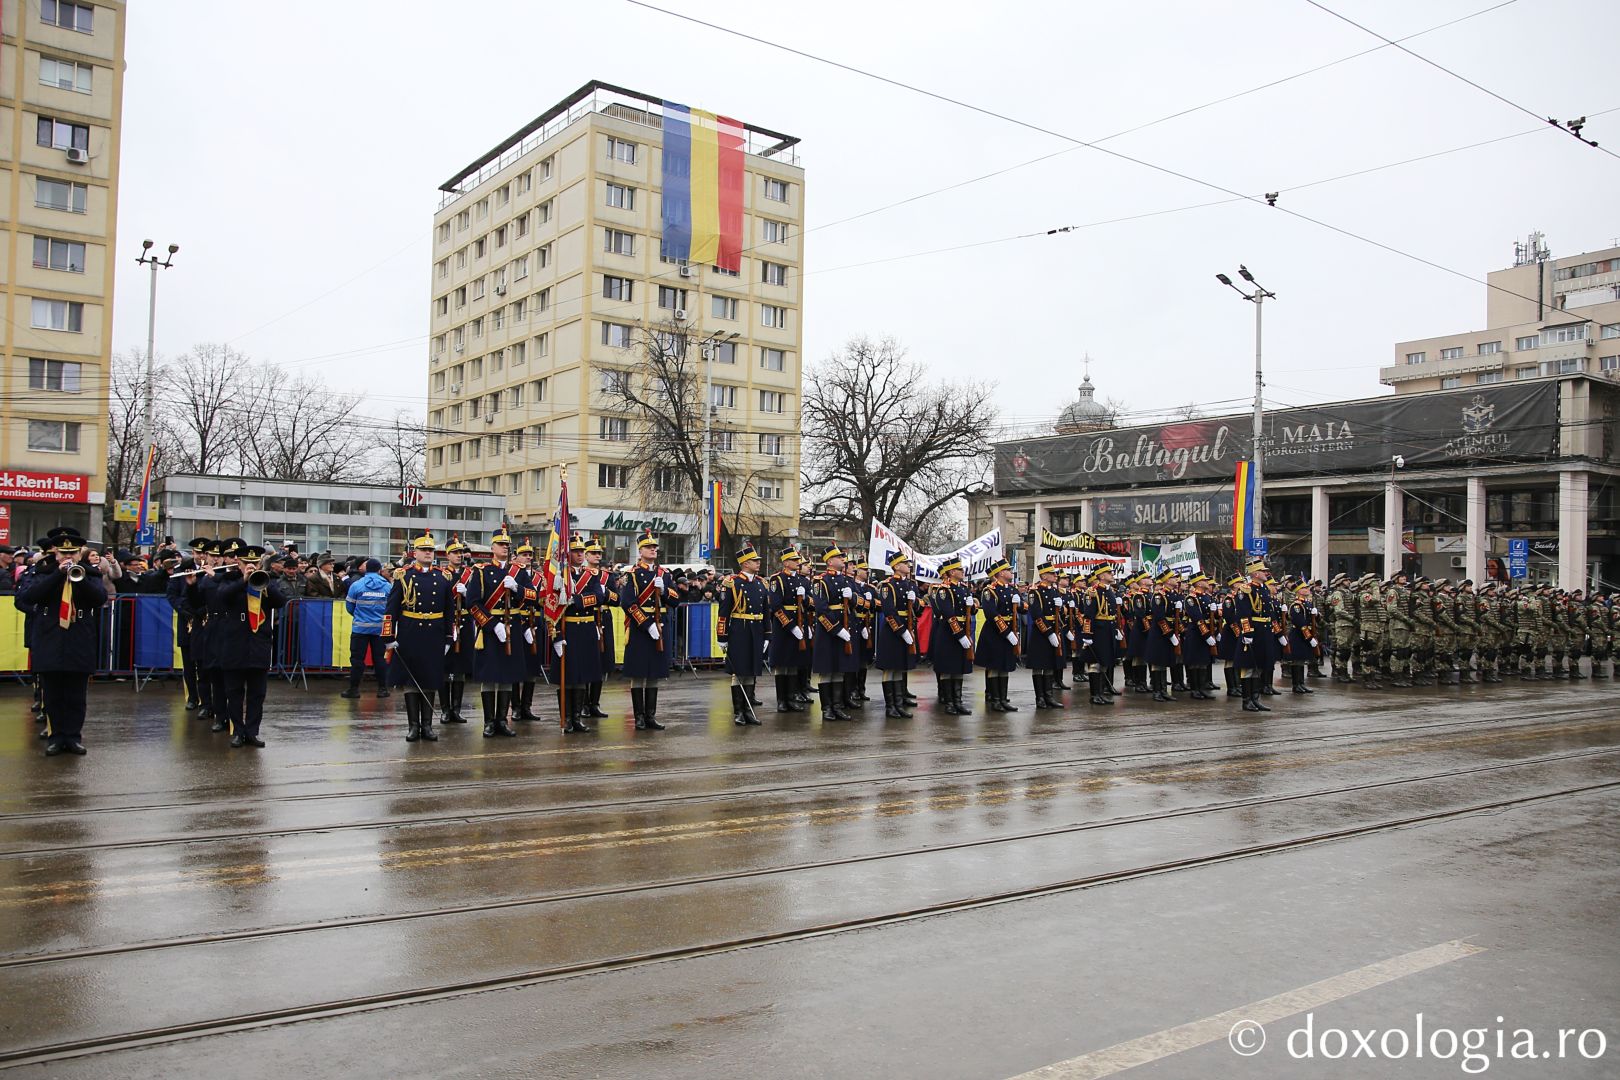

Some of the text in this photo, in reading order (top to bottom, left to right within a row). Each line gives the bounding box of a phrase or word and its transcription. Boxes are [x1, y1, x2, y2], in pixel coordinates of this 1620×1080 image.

[1281, 420, 1355, 445] MAIA
[1445, 433, 1511, 448] ATENEUL
[1083, 425, 1229, 479] Baltagul
[16, 474, 53, 489] Rent
[54, 476, 81, 491] Iasi
[403, 487, 420, 507] BZI
[602, 510, 678, 533] Marelbo
[1134, 503, 1168, 524] SALA
[1171, 501, 1210, 523] UNIRII
[981, 531, 1000, 549] NU
[701, 545, 708, 556] P
